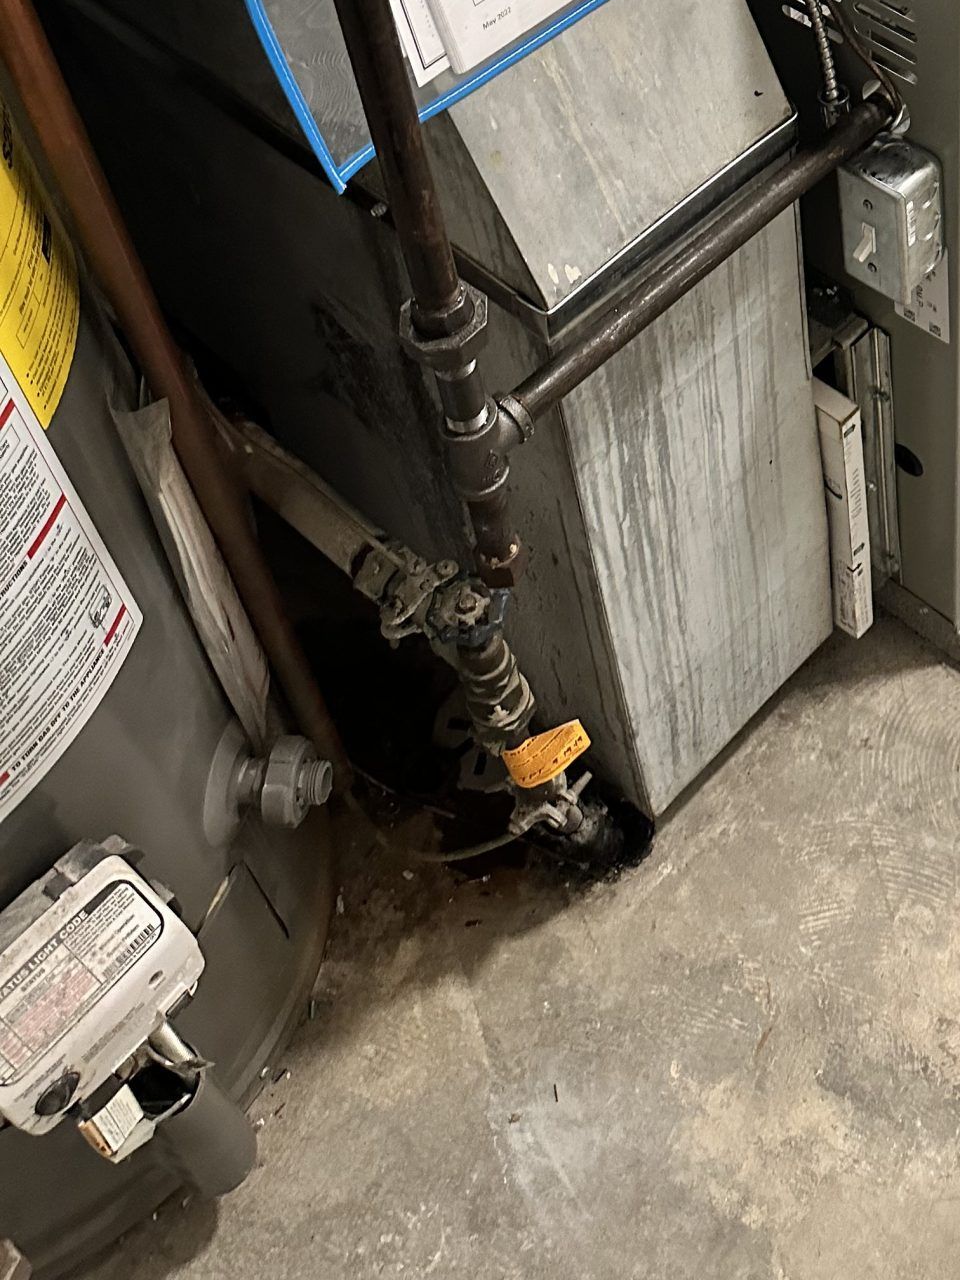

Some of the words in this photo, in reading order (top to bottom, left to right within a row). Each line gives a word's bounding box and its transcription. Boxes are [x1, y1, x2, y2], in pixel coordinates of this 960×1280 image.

[482, 16, 497, 31] May
[0, 560, 27, 600] RUCTIONS
[12, 761, 21, 771] TO
[22, 742, 38, 761] TURN
[38, 726, 50, 742] GAS
[50, 712, 61, 727] OFF
[62, 702, 70, 712] TO
[70, 687, 80, 701] THE
[80, 649, 104, 687] APPLIANCE
[0, 968, 29, 999] ATUS
[28, 941, 58, 968] LIGHT
[60, 910, 88, 939] CODE
[21, 968, 46, 992] STATUS
